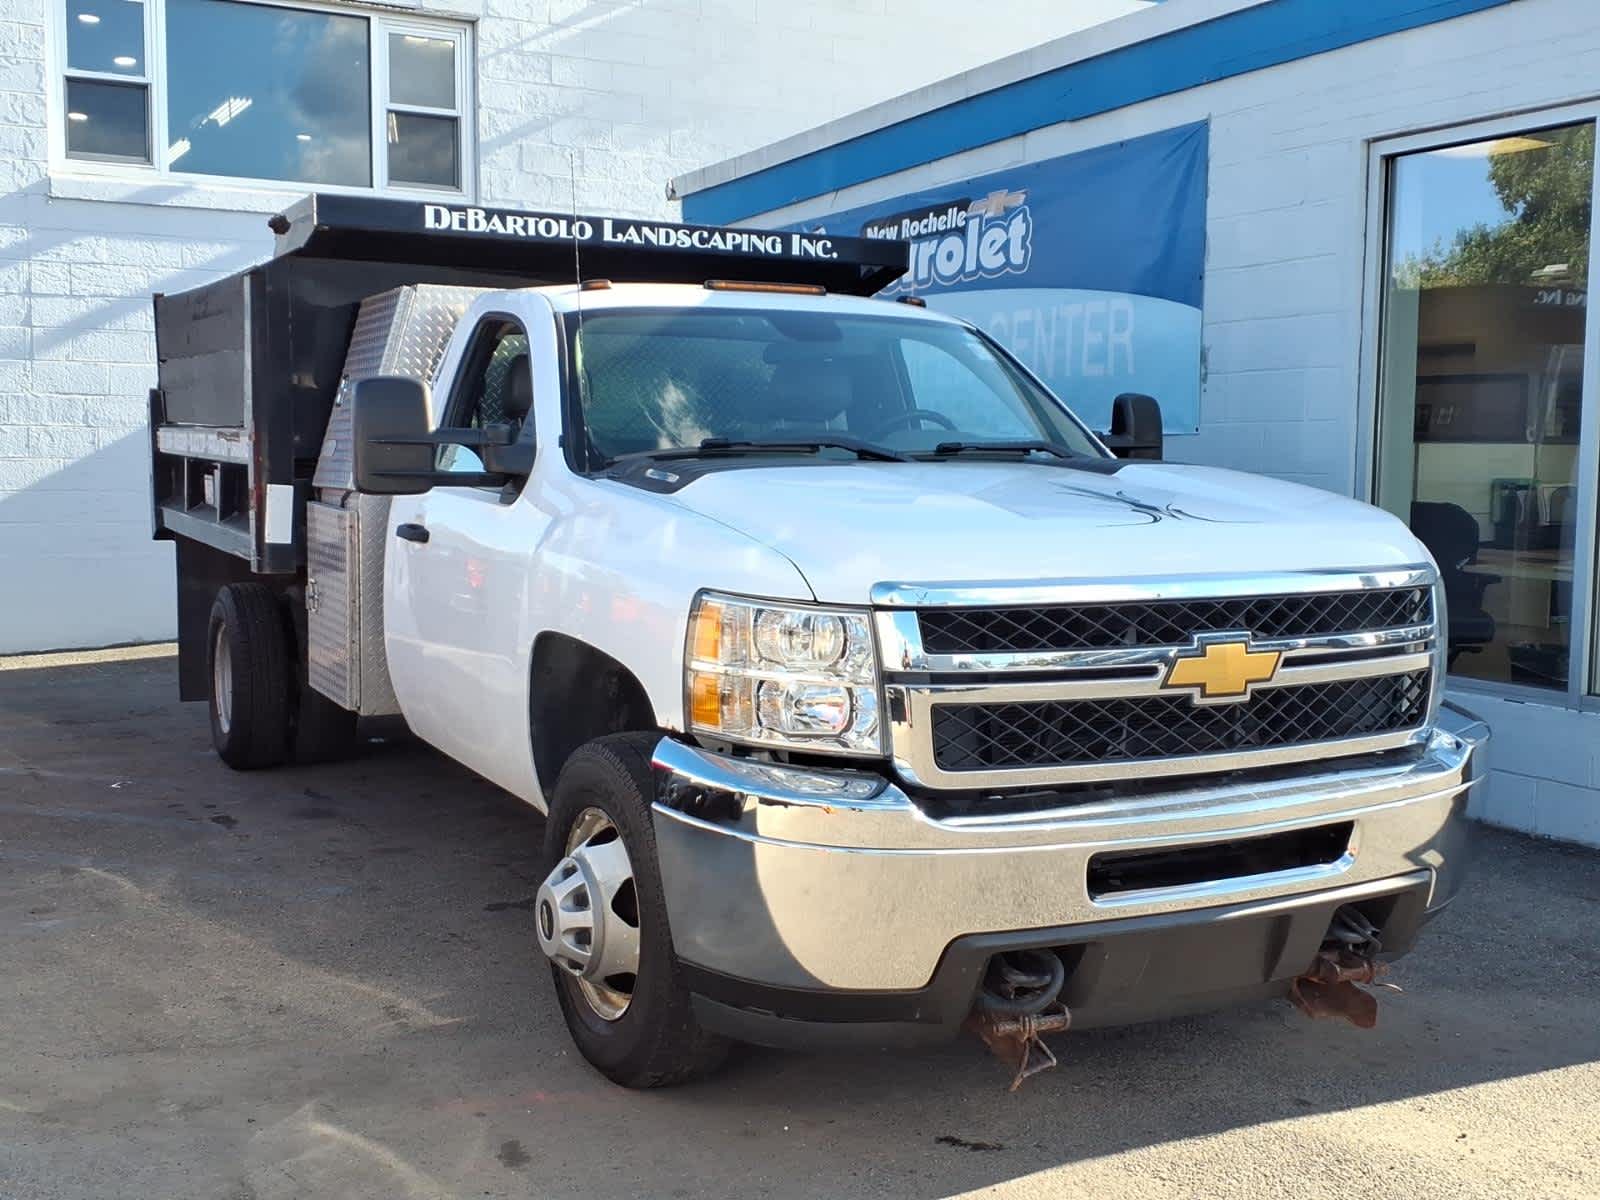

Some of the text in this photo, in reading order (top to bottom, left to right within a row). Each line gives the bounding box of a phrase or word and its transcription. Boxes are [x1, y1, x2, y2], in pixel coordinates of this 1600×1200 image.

[603, 219, 781, 254] LANDSCAPING
[791, 233, 839, 259] INC.
[901, 206, 967, 239] Rochelle
[904, 211, 1026, 283] rolet
